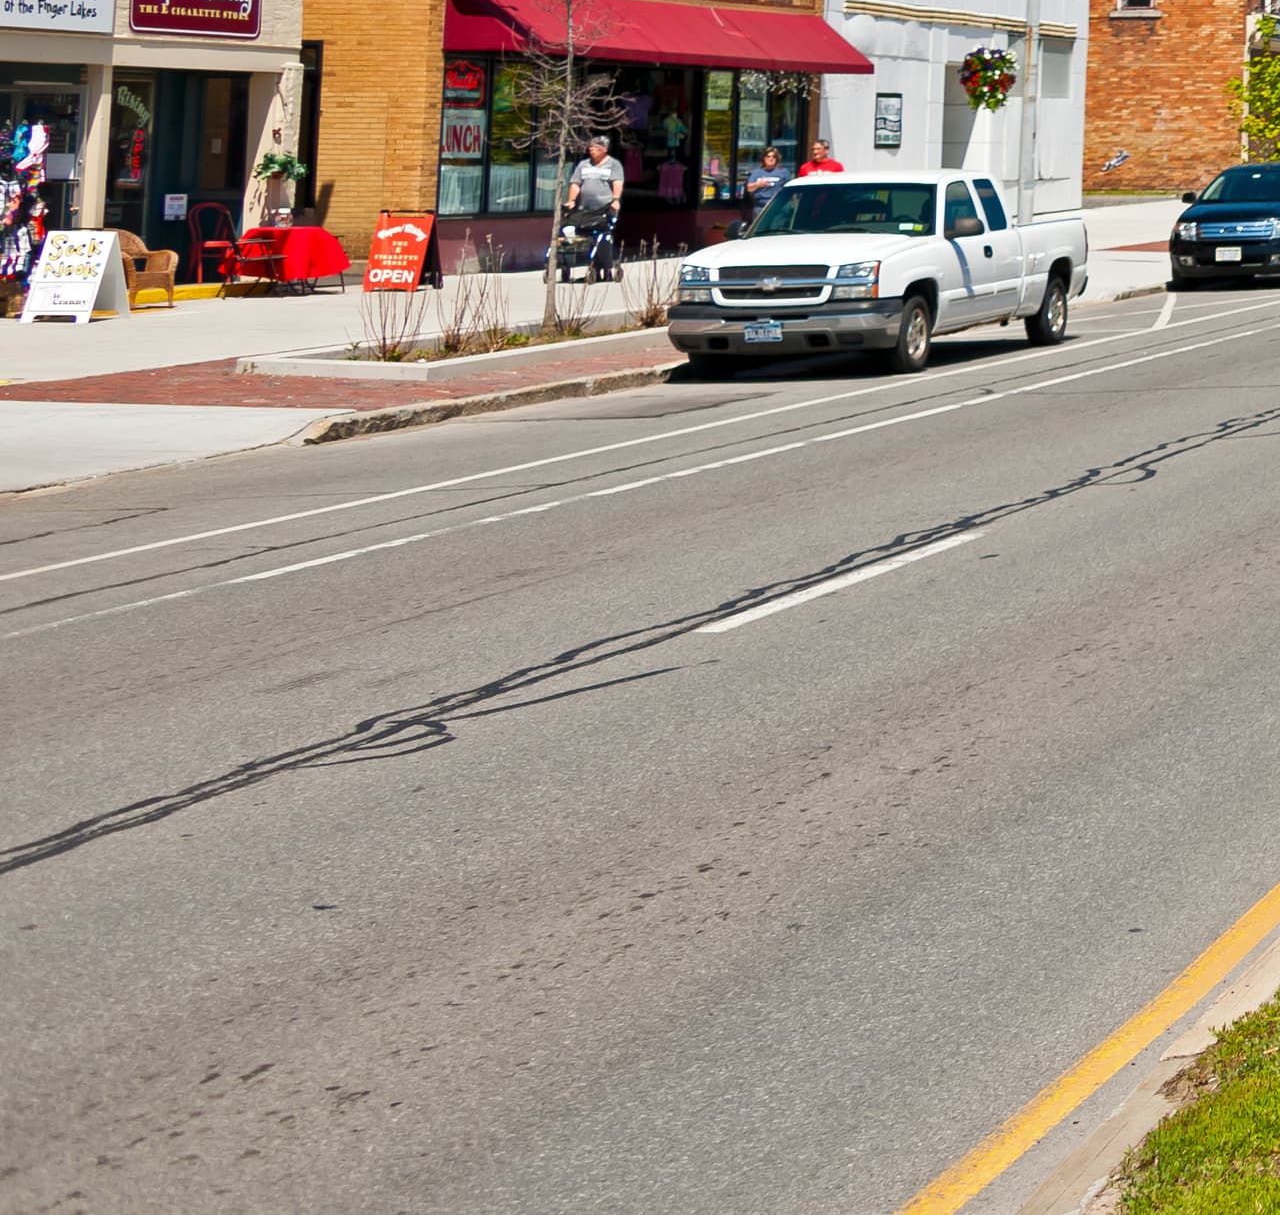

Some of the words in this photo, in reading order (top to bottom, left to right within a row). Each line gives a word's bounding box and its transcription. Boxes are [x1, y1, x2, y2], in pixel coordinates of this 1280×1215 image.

[70, 2, 97, 19] Lakes
[139, 4, 158, 15] THE
[160, 2, 169, 15] E
[171, 5, 221, 19] CIGARETTE
[48, 234, 104, 261] Sock
[43, 261, 101, 280] Nook
[369, 269, 415, 283] OPEN
